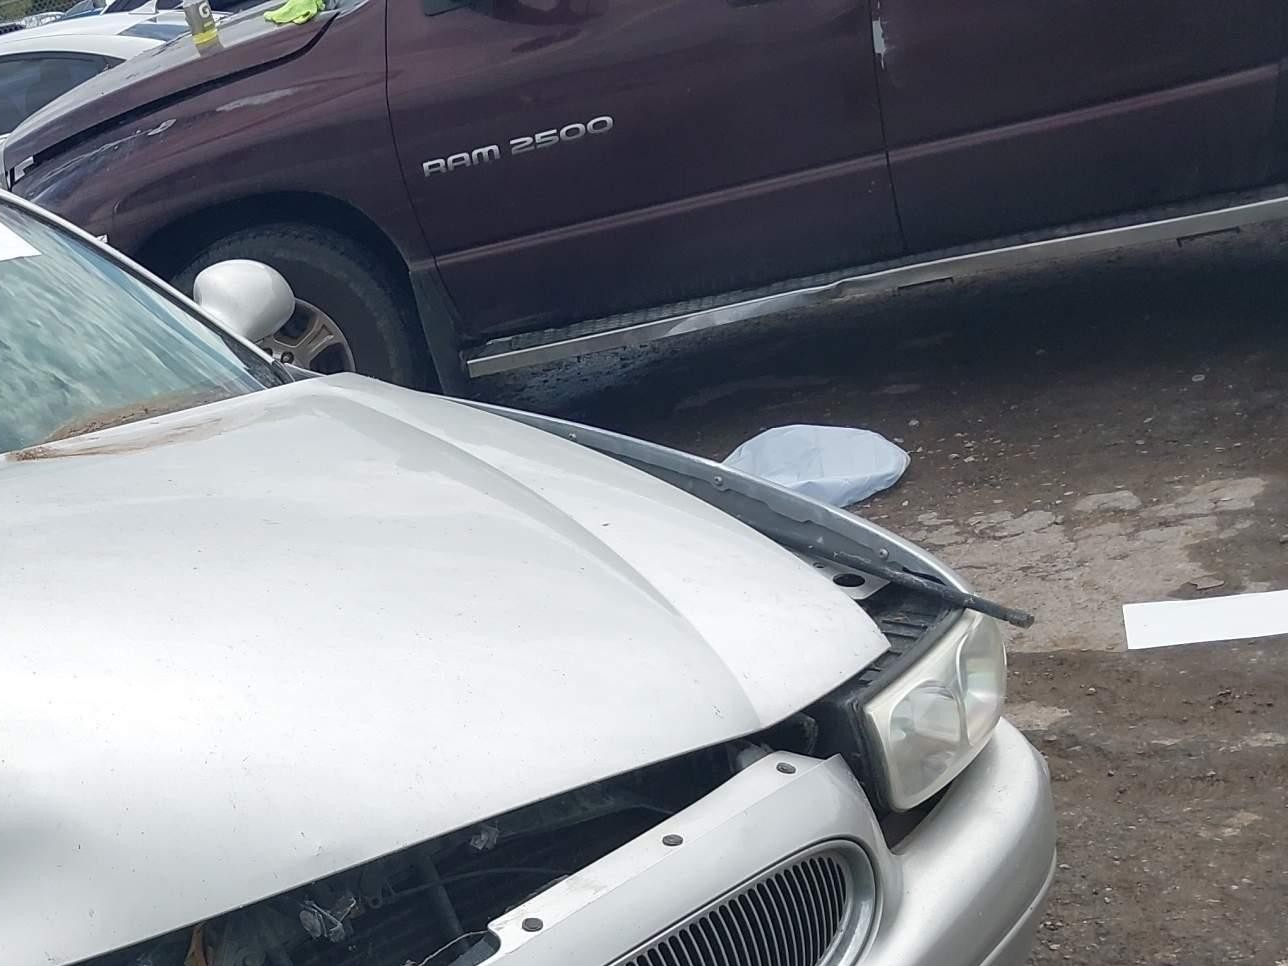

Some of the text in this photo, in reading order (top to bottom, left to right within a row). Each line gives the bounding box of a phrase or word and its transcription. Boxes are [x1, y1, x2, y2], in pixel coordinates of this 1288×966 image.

[199, 2, 211, 18] G
[422, 115, 614, 177] RAM 2500
